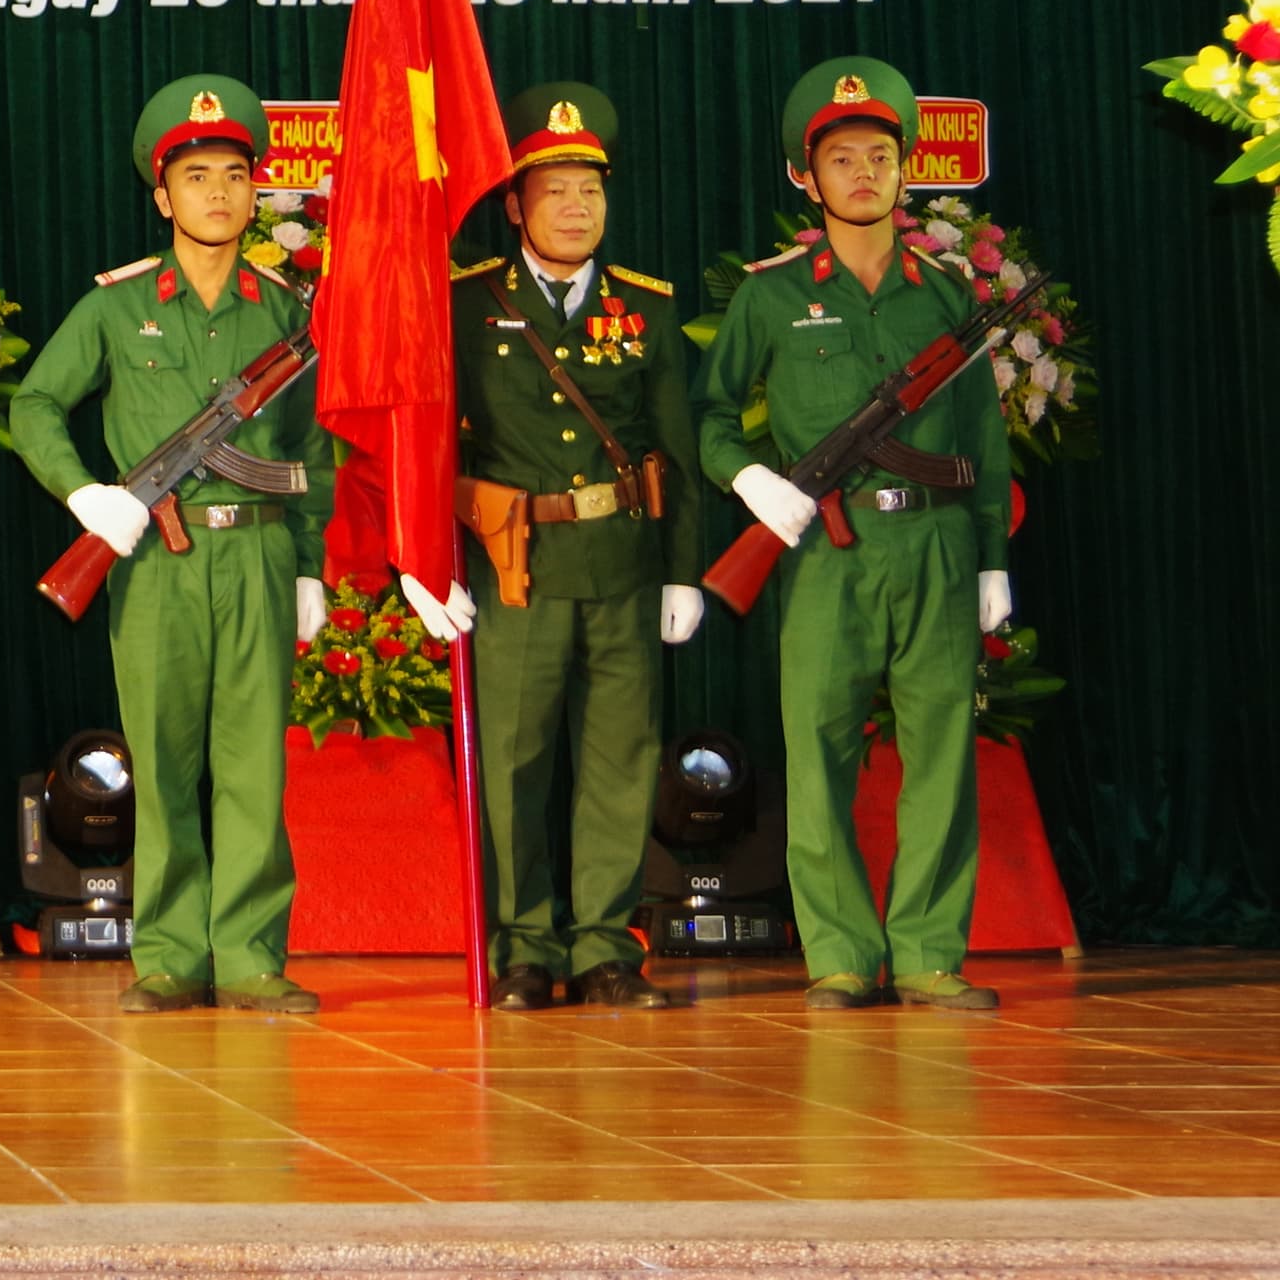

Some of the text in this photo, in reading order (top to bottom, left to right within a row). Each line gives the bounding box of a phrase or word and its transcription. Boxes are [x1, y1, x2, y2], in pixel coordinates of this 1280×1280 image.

[282, 114, 313, 154] HẬU
[937, 112, 965, 142] KHU
[967, 113, 978, 142] 5
